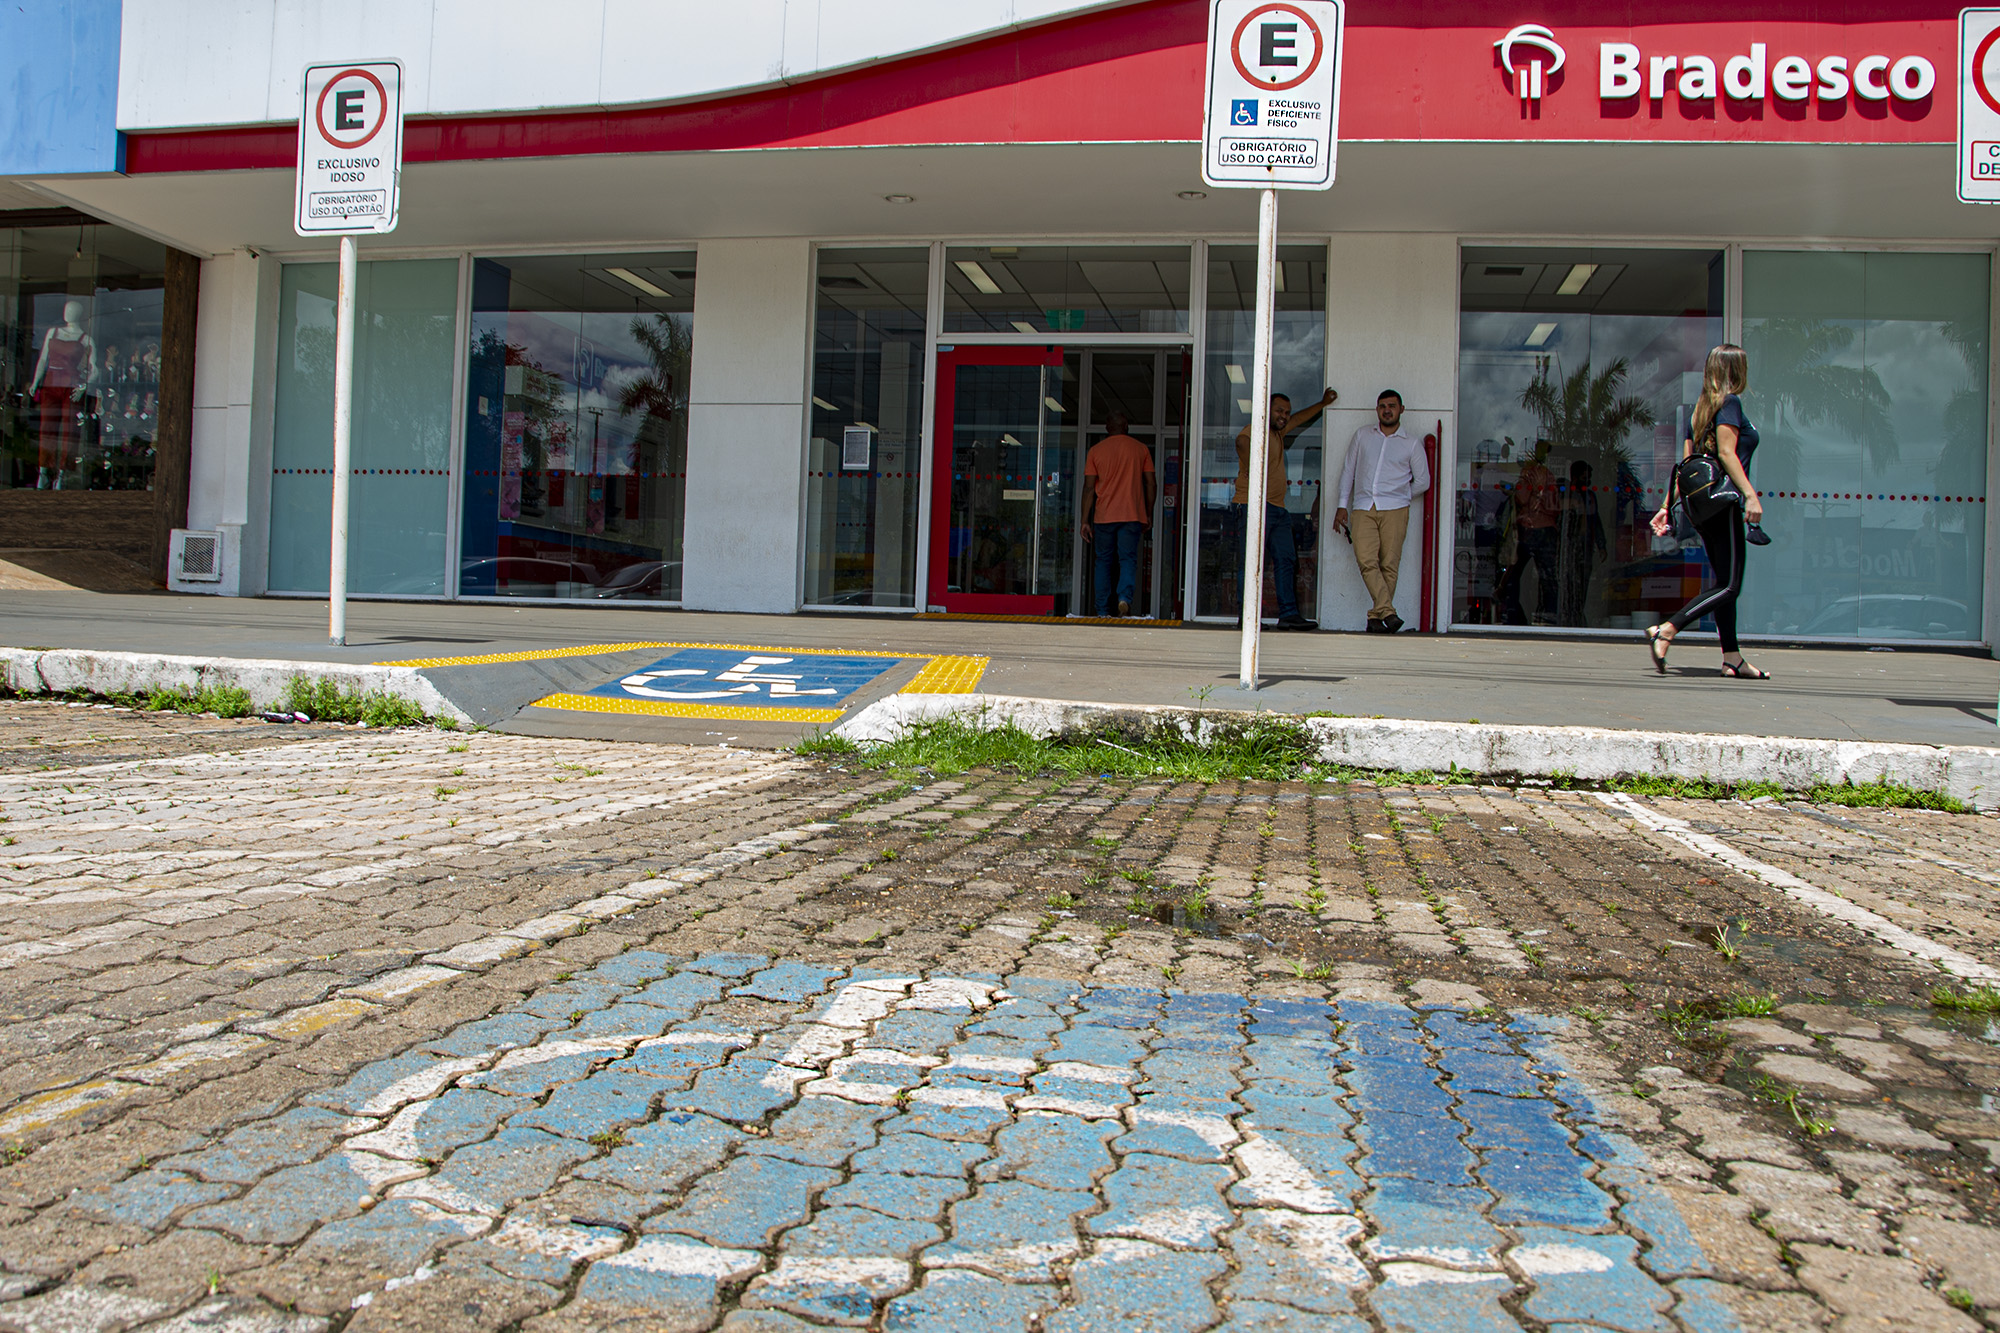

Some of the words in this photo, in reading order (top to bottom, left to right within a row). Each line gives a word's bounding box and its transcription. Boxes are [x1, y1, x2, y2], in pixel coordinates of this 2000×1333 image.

[1259, 23, 1298, 67] E
[1600, 43, 1936, 100] Bradesco
[336, 90, 365, 130] E
[1268, 100, 1321, 110] EXCLUSIVO
[1267, 109, 1322, 120] DEFICIENTE
[1267, 118, 1298, 128] FÍSICO
[1230, 141, 1307, 153] OBRIGATÓRIO
[317, 157, 380, 170] EXCLUSIVO
[1221, 154, 1245, 163] USO
[1248, 154, 1265, 164] DO
[1267, 153, 1314, 165] CARTÃO
[330, 172, 366, 183] IDOSO
[318, 193, 378, 205] OBRIGATÓRIO
[312, 206, 330, 216] USO
[332, 206, 345, 215] DO
[346, 203, 383, 214] CARTÃO
